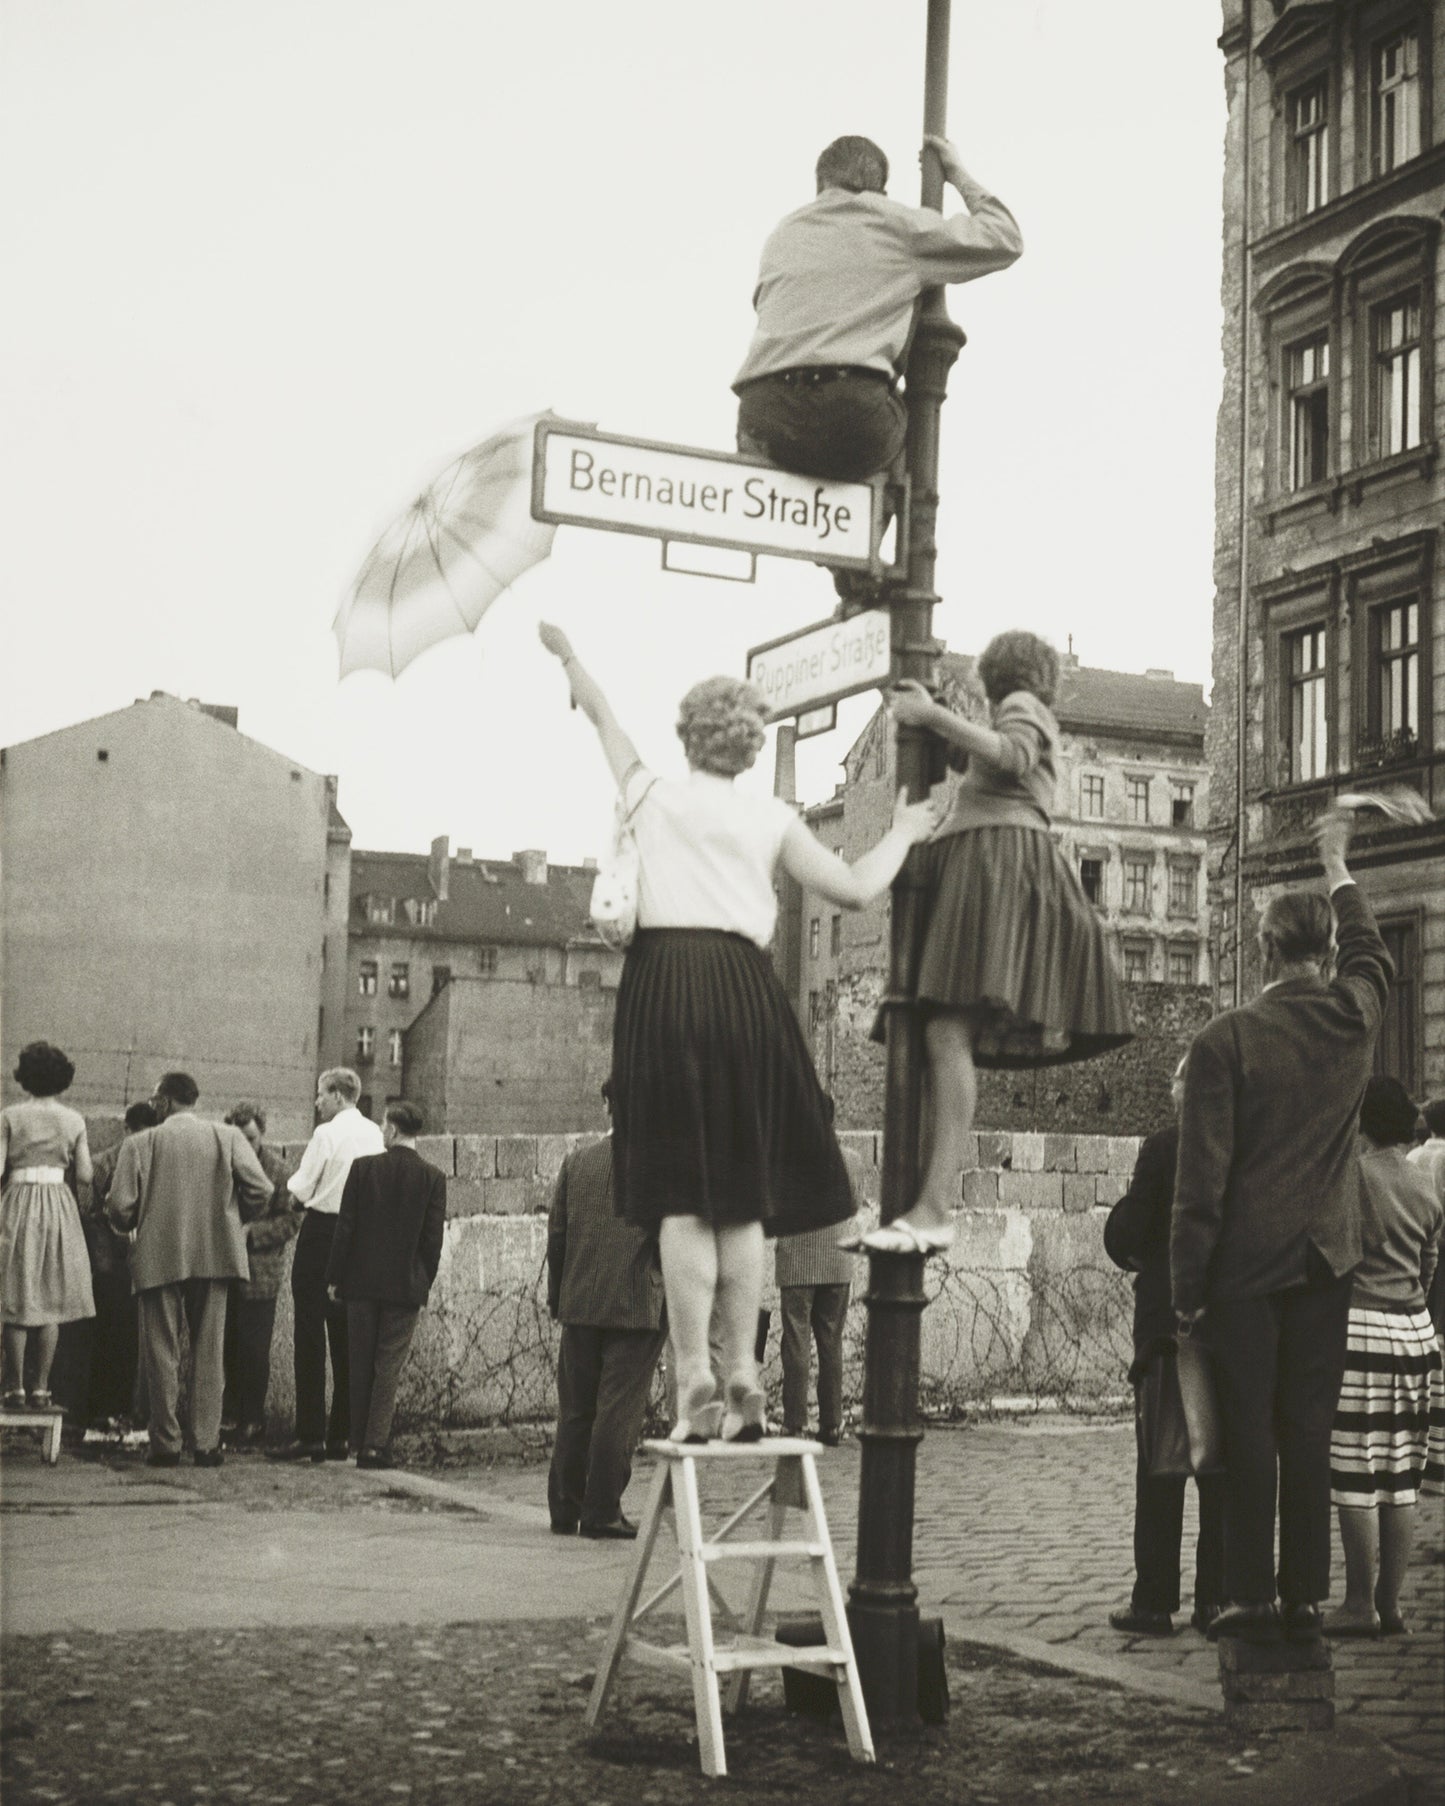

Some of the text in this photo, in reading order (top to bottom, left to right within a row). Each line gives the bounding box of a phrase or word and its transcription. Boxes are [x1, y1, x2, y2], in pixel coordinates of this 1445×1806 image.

[570, 449, 851, 538] Bernauer Straße
[830, 619, 886, 672] Straße
